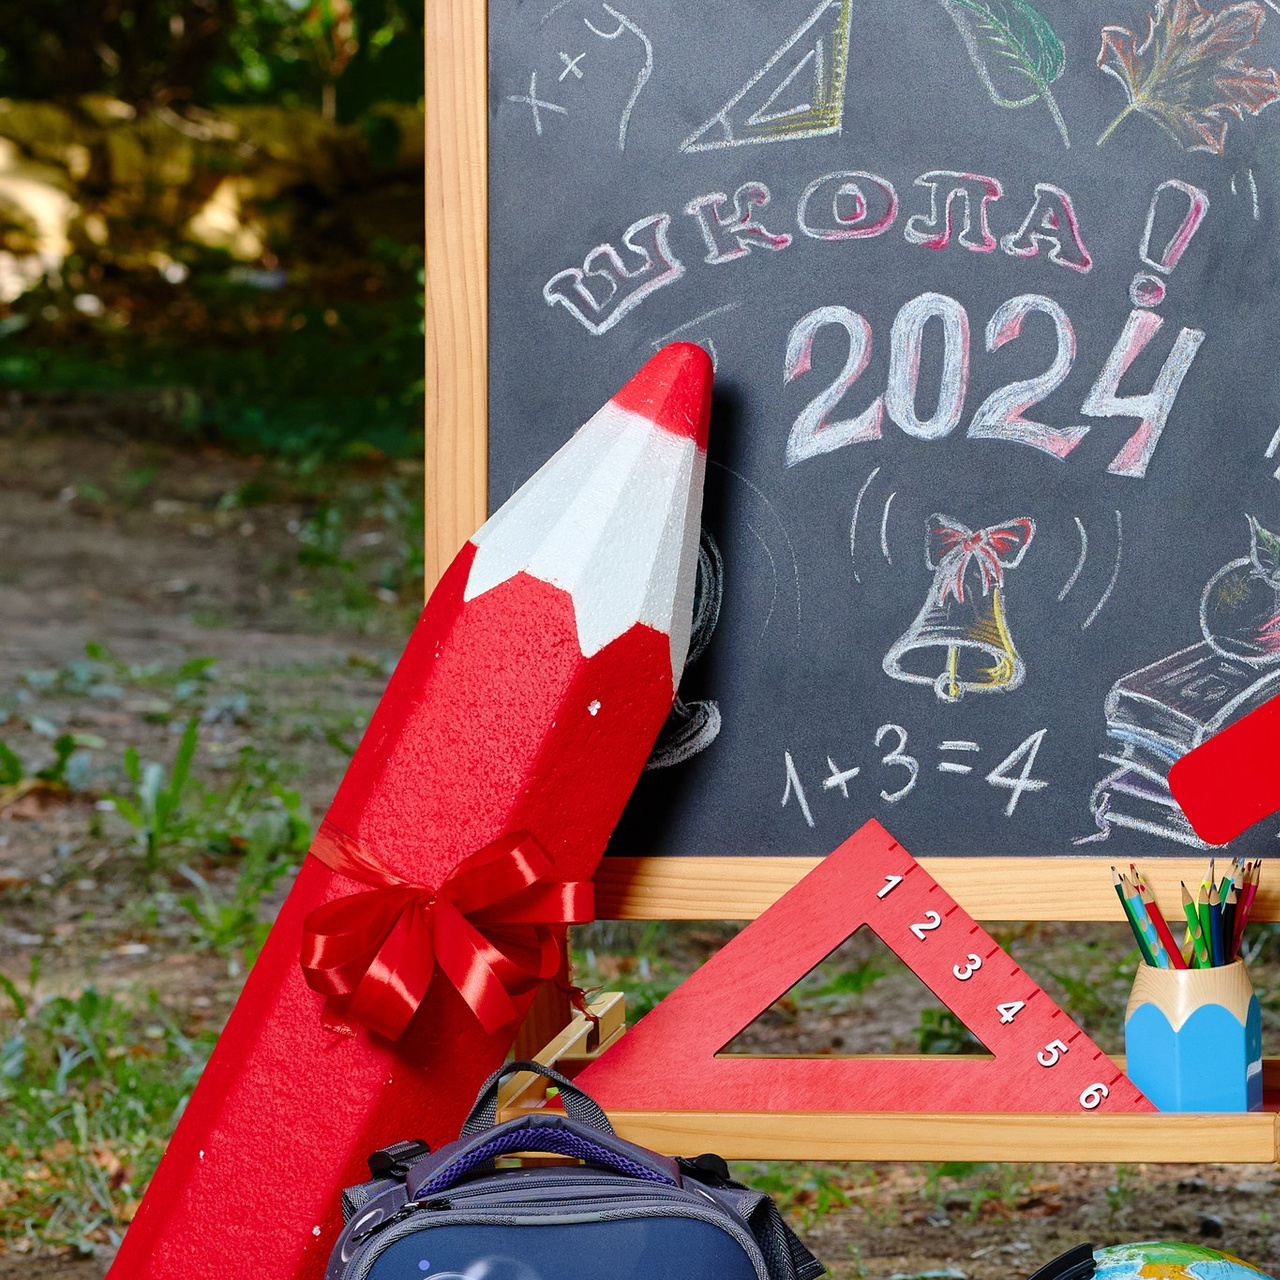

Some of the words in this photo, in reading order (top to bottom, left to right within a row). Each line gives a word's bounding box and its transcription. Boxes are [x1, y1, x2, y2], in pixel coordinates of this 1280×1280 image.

[783, 290, 1206, 479] 2024
[876, 873, 903, 900] 1
[909, 910, 942, 940] 2
[953, 953, 982, 981] 3
[995, 999, 1026, 1025] 4
[1037, 1038, 1068, 1068] 5
[1079, 1082, 1109, 1110] 6
